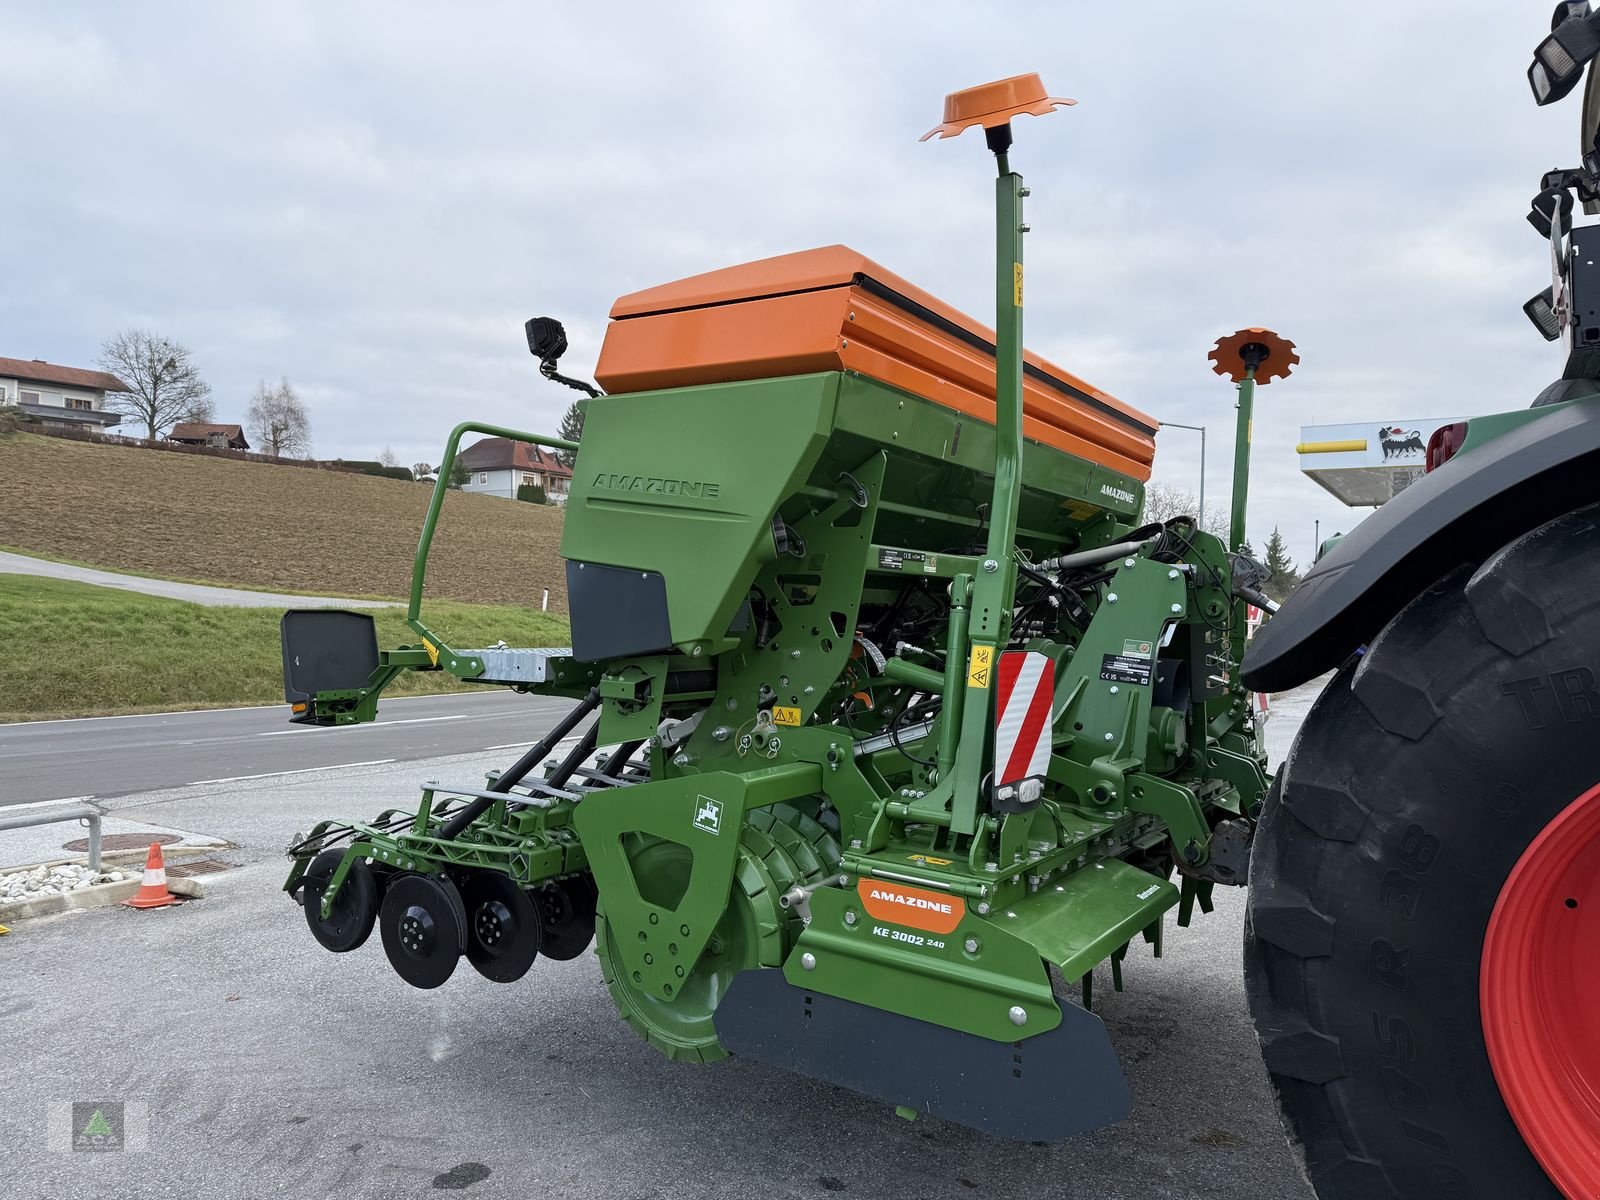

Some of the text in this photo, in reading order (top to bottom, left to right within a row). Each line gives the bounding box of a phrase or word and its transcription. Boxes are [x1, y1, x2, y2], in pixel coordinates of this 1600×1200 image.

[592, 473, 720, 500] AMAZONE
[1100, 484, 1135, 504] AMAZONE
[1377, 823, 1441, 921] 38
[870, 889, 953, 915] AMAZONE
[872, 926, 945, 949] KE 3002 240
